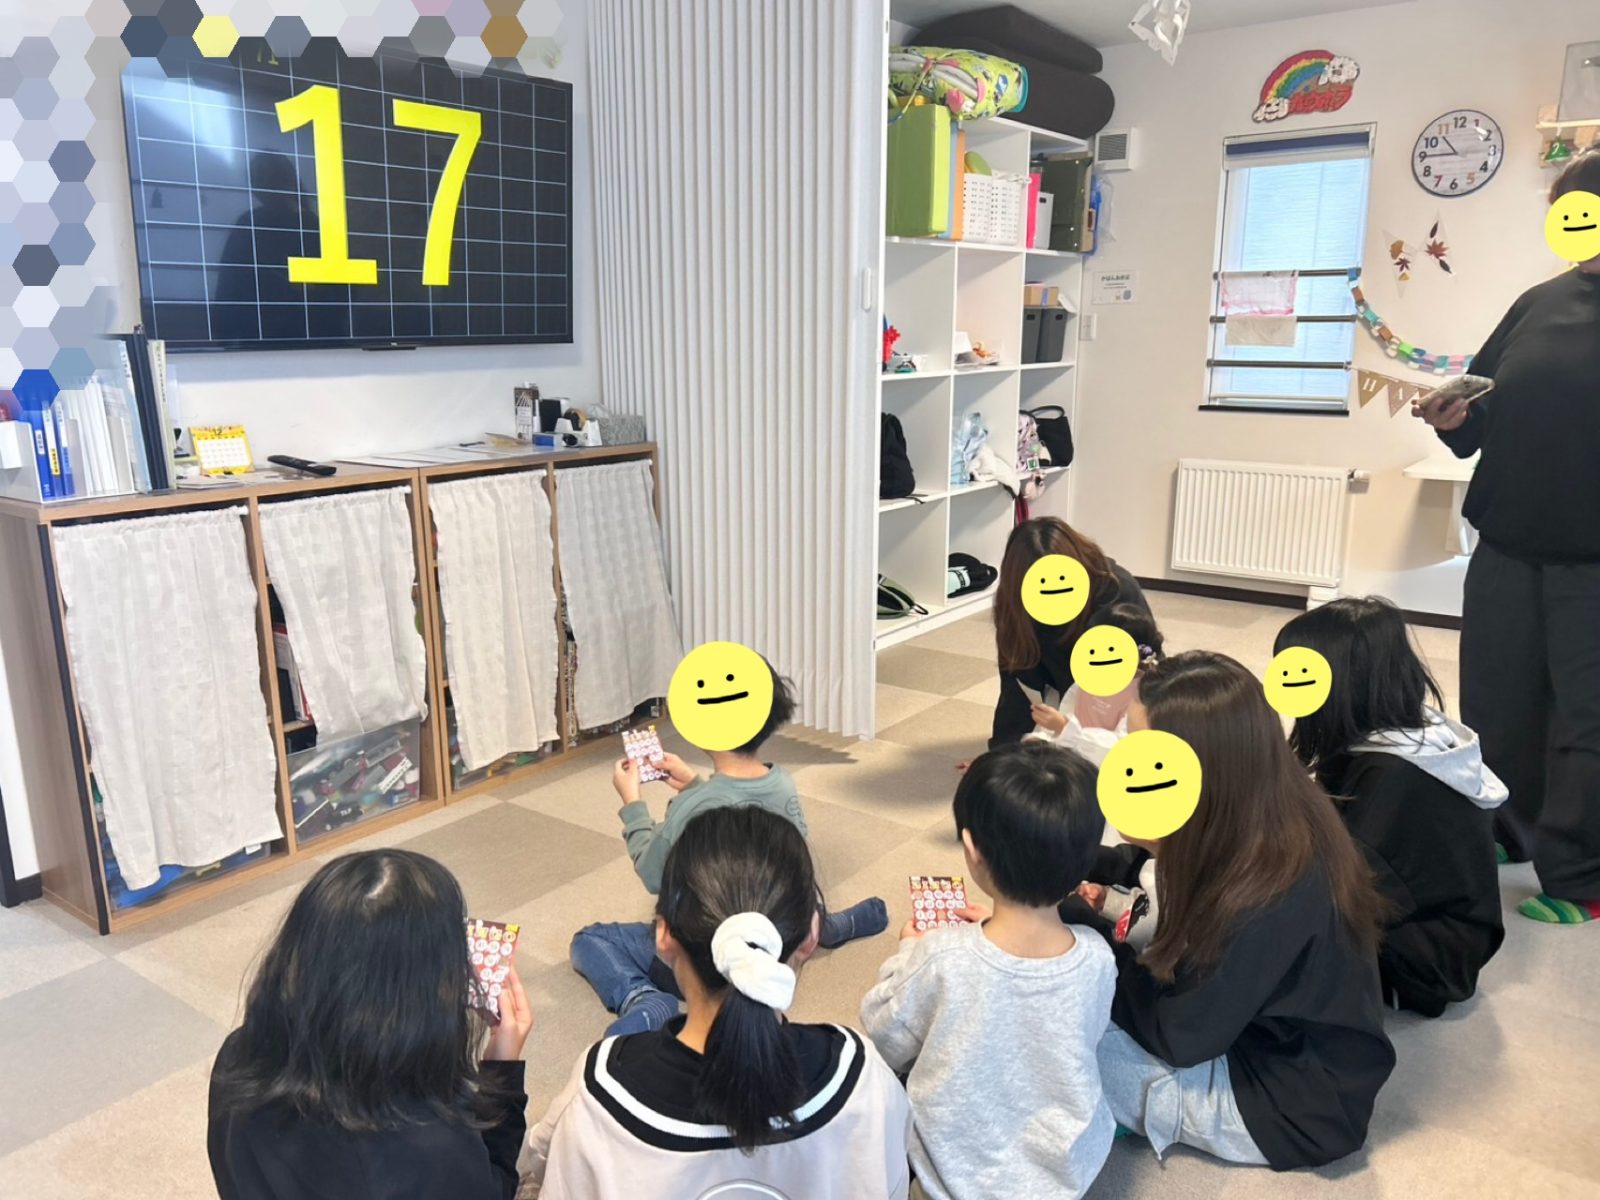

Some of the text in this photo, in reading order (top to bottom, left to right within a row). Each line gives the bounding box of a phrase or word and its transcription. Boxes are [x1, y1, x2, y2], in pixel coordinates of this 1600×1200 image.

[1453, 116, 1467, 128] 12
[1473, 119, 1480, 127] 1
[1438, 123, 1450, 135] 11
[1483, 129, 1492, 142] 2
[1424, 136, 1439, 149] 10
[1488, 144, 1497, 156] 3
[1418, 151, 1427, 163] 9
[1423, 165, 1431, 177] 8
[1479, 160, 1489, 172] 4
[1434, 175, 1443, 188] 7
[1449, 178, 1458, 190] 6
[1466, 172, 1476, 185] 5
[275, 85, 481, 286] 17
